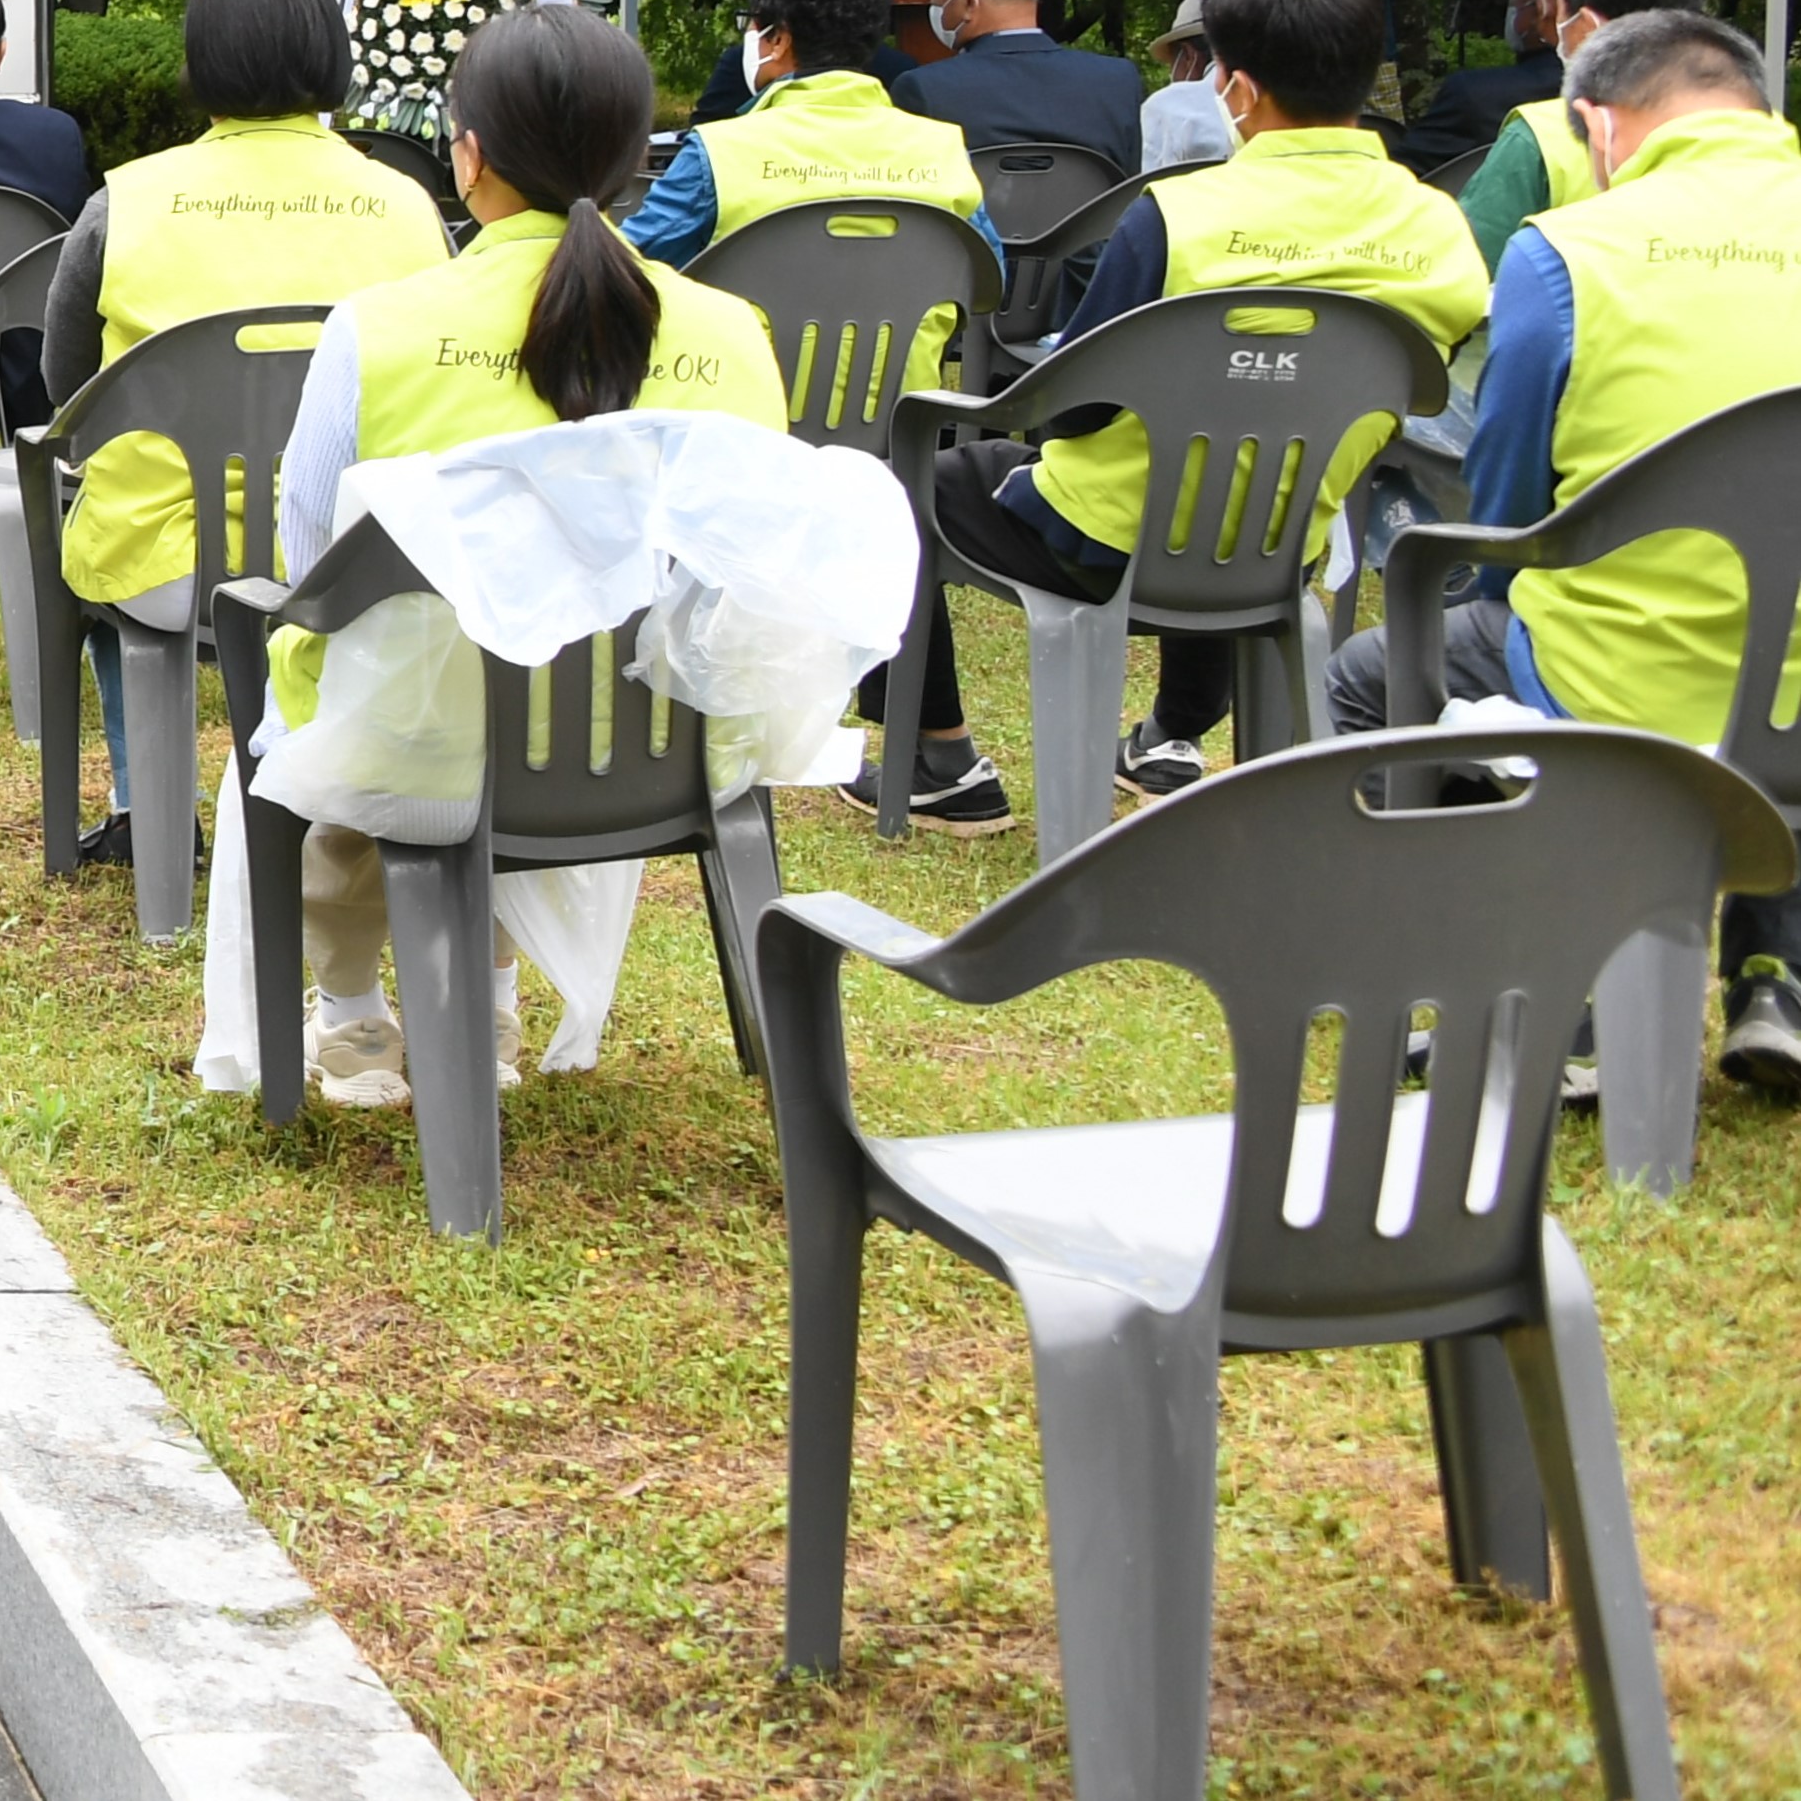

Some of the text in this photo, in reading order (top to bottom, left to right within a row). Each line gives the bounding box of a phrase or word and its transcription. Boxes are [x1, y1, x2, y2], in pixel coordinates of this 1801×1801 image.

[762, 160, 939, 185] Everything will be OK!
[170, 193, 386, 221] Everything will be OK!
[1343, 241, 1376, 262] will
[1403, 250, 1432, 278] OK!
[1645, 237, 1785, 274] Everything
[673, 353, 720, 386] OK!
[1229, 349, 1300, 370] CLK
